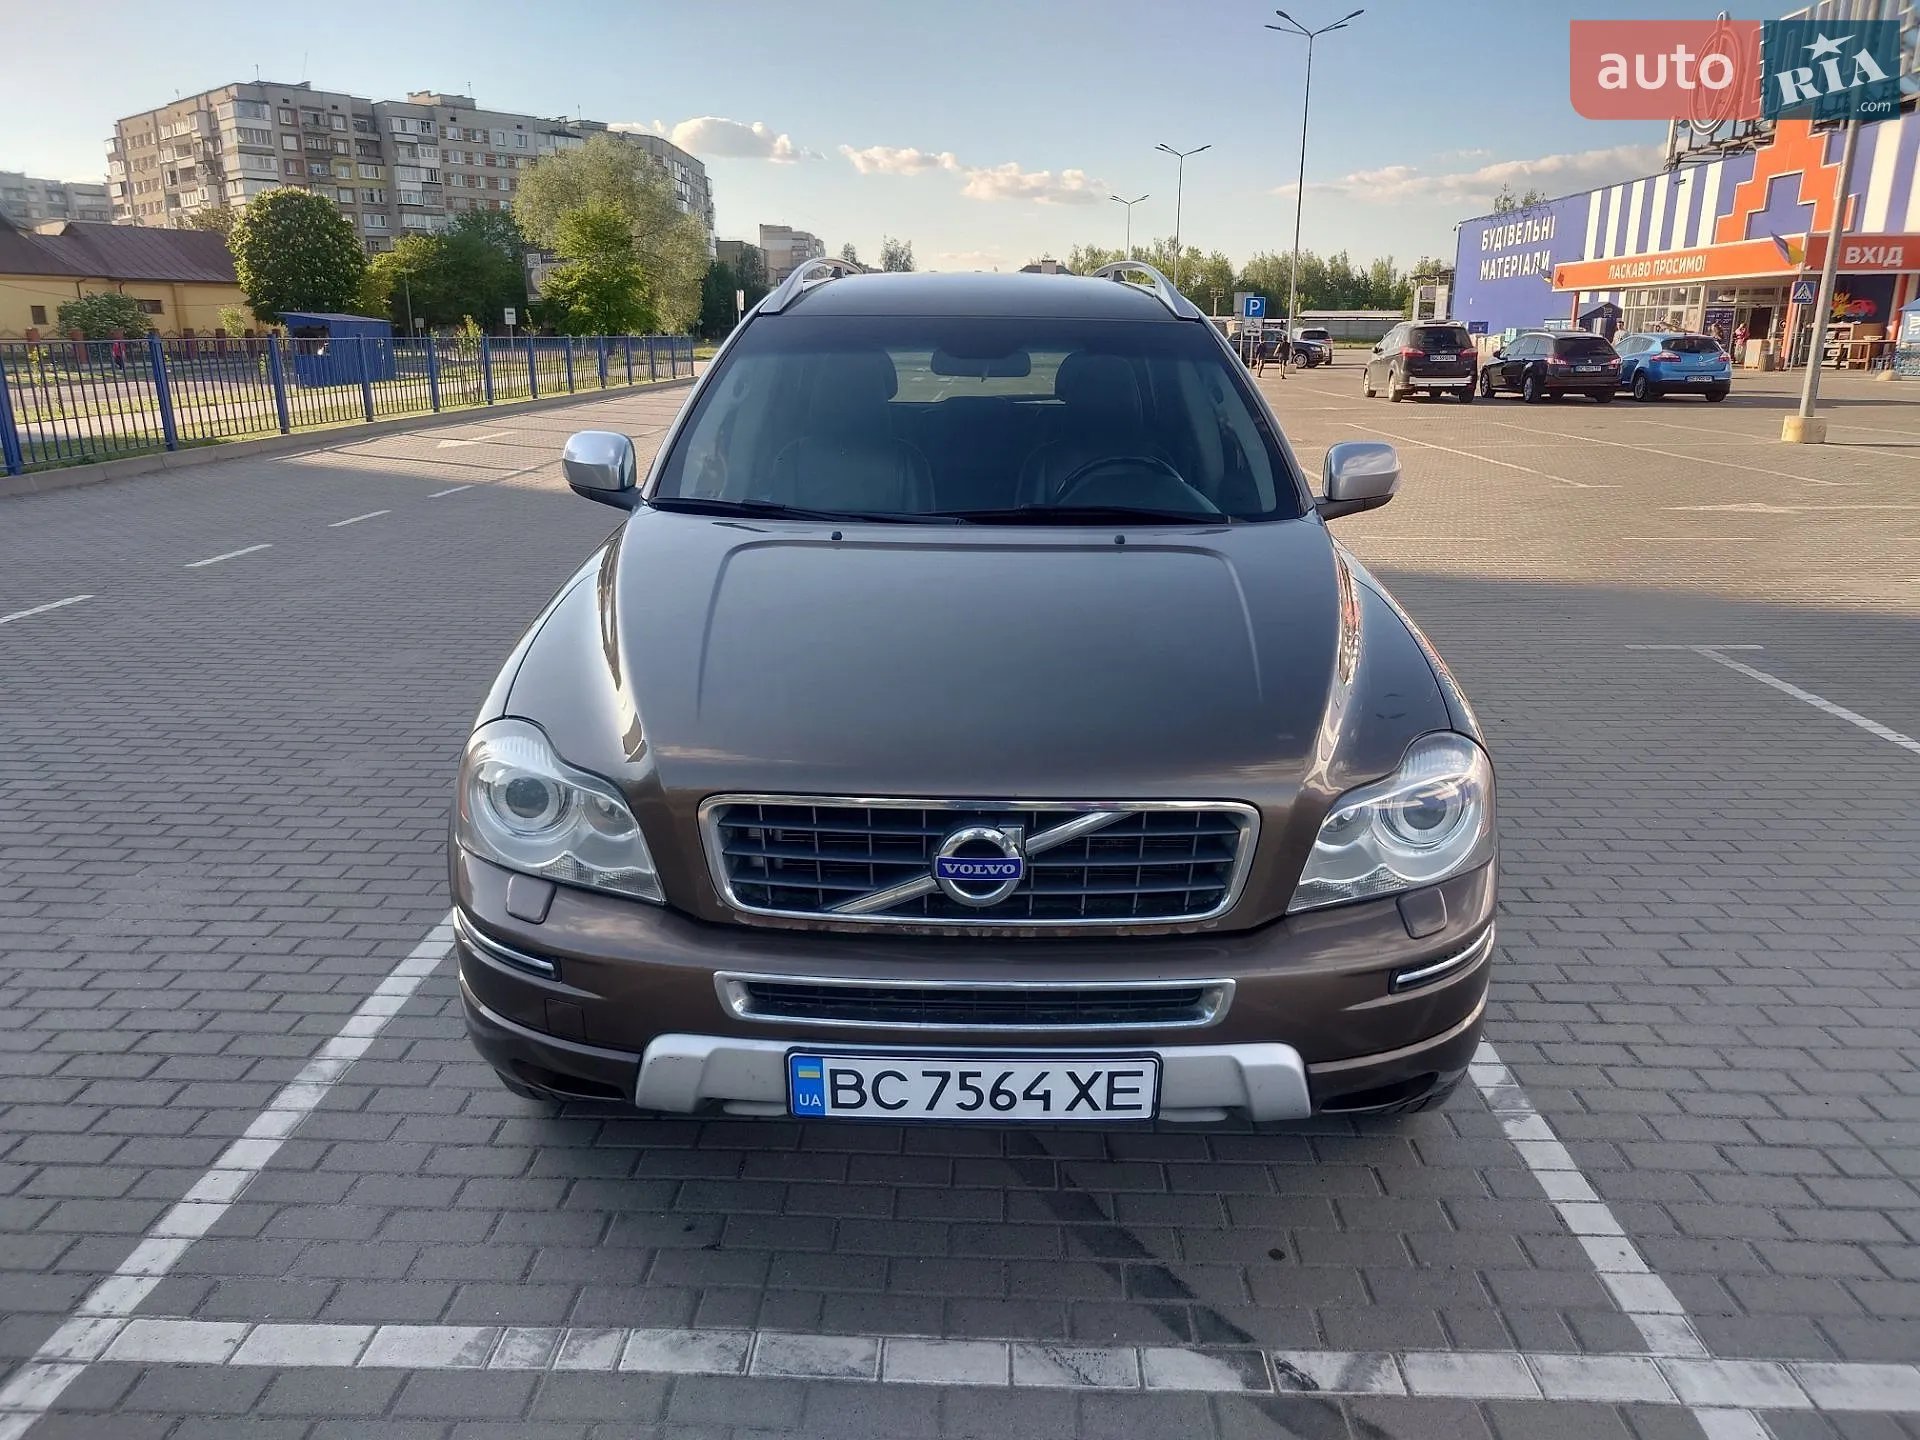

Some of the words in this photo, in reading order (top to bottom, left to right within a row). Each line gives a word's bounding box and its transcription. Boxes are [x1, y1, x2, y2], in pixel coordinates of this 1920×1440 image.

[1481, 215, 1556, 252] БУДІВЕЛЬНІ
[1480, 250, 1551, 281] МАТЕРІАЛИ
[1608, 260, 1651, 280] ЛАСКАВО
[1653, 254, 1708, 276] ПРОСИМО!
[1844, 246, 1905, 267] ВХІД
[1249, 299, 1261, 316] P
[942, 863, 1016, 875] VOLVO
[799, 1093, 822, 1108] UA
[829, 1068, 910, 1110] BC
[921, 1070, 1051, 1112] 7564
[1064, 1070, 1144, 1111] XE
